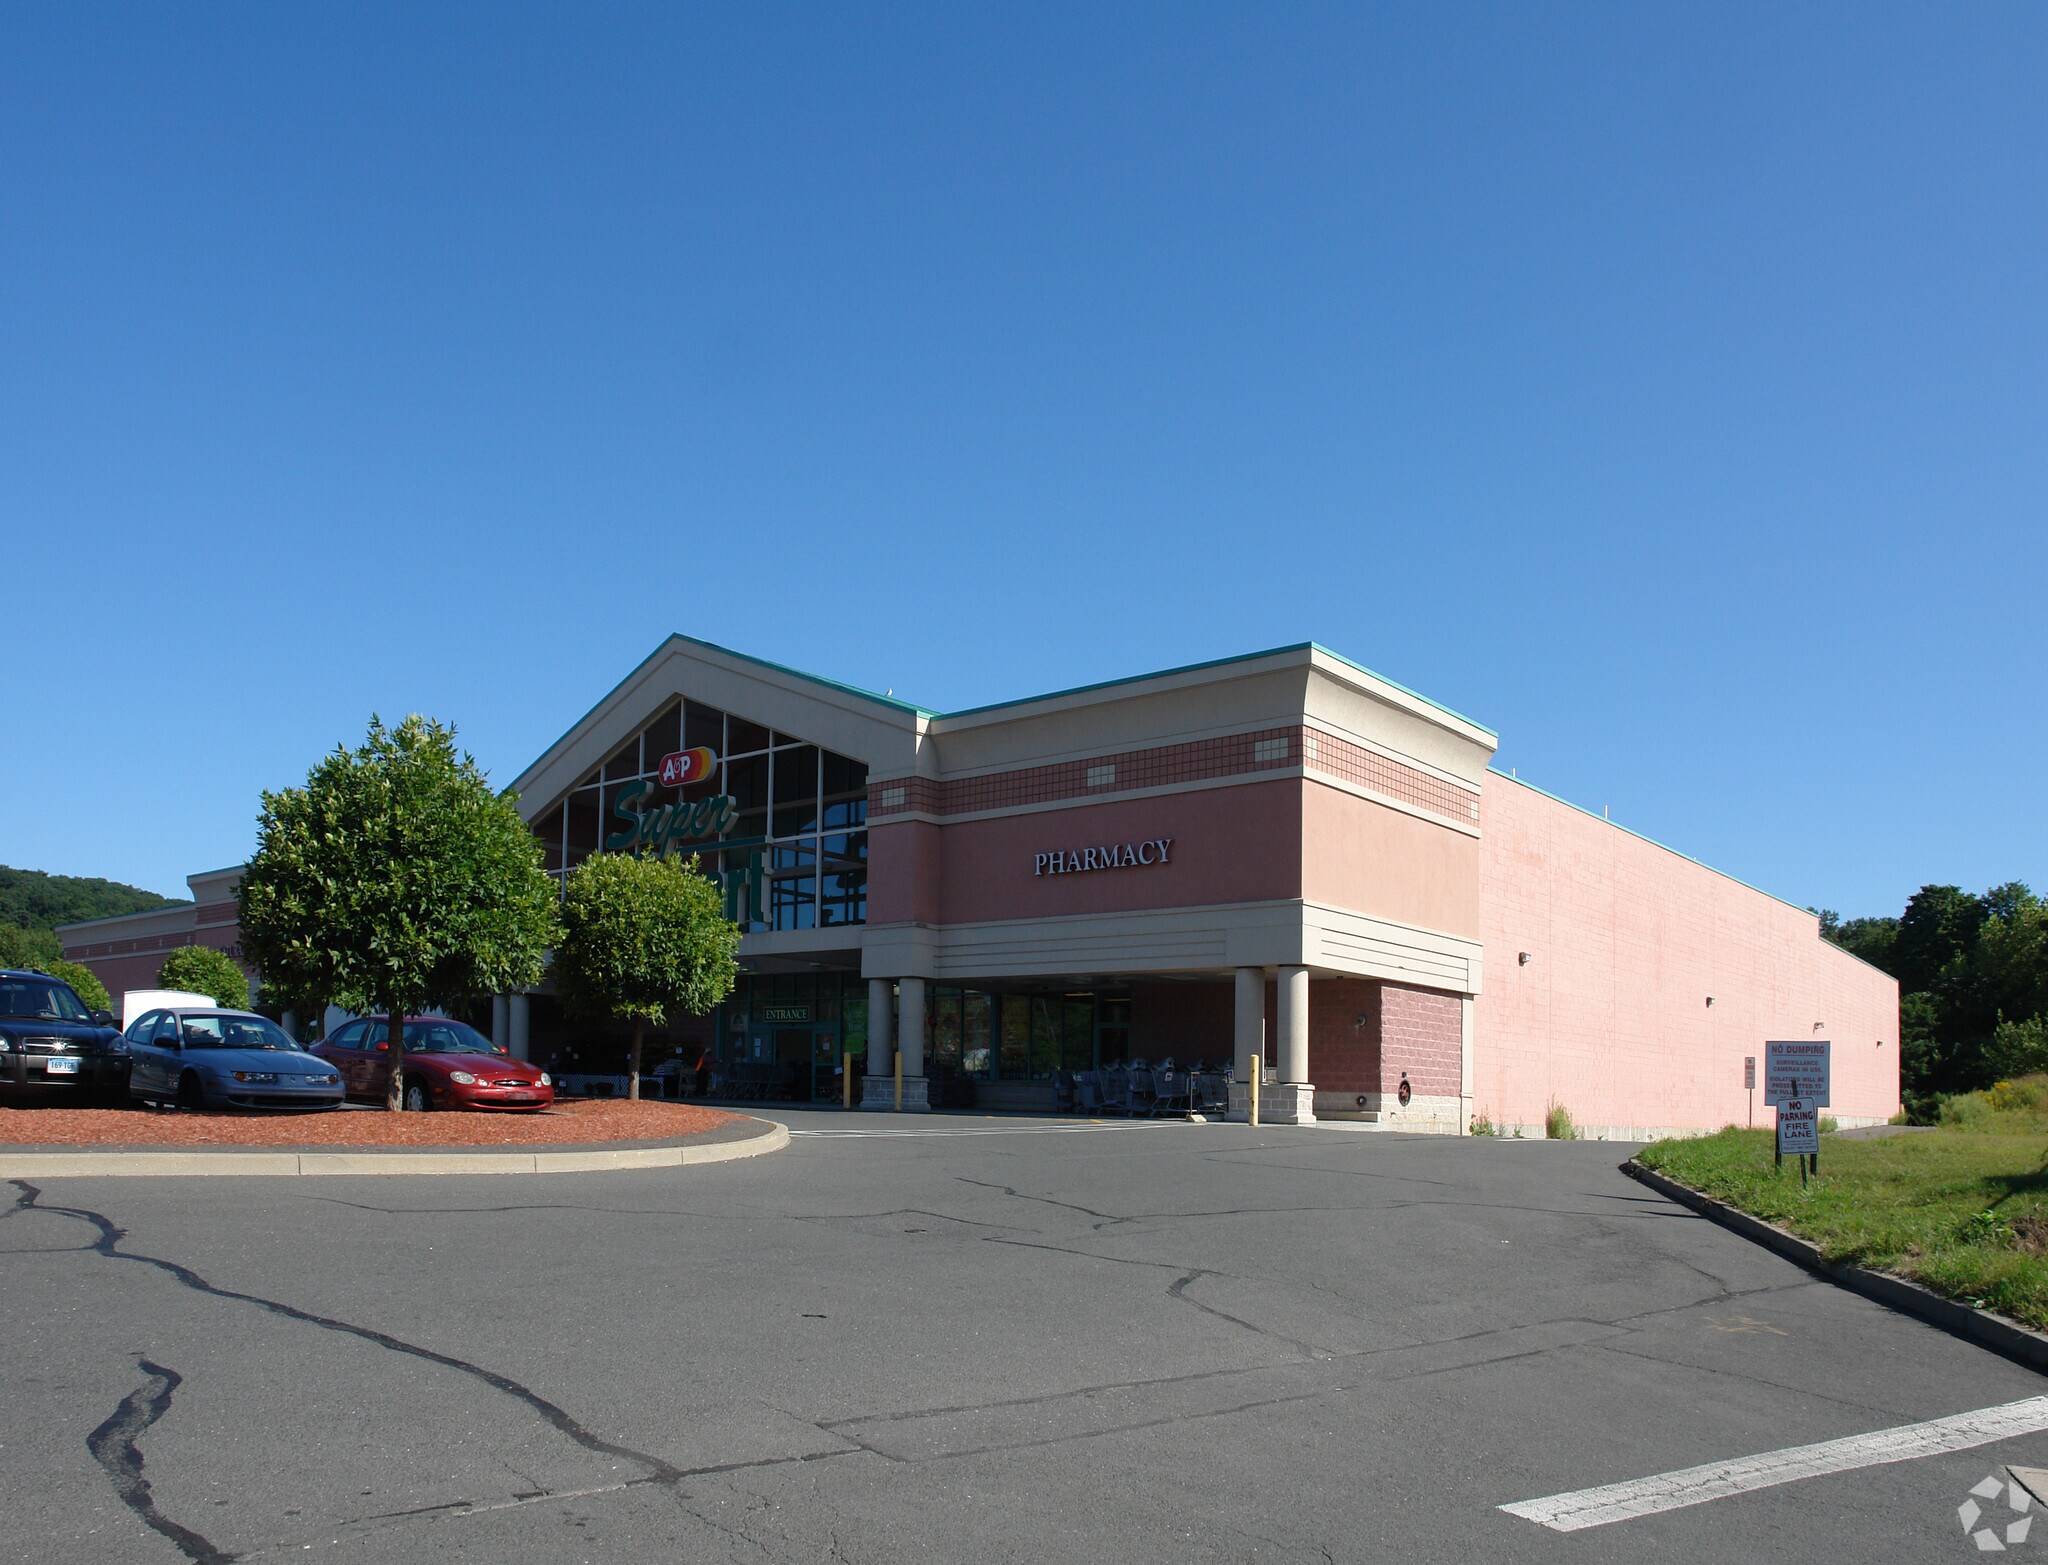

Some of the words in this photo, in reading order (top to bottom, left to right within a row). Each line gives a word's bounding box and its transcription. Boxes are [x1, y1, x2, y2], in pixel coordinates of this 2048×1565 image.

[663, 756, 690, 781] A&P
[606, 781, 738, 859] Super
[1034, 839, 1171, 875] PHARMACY
[766, 1009, 807, 1019] ENTRANCE
[1772, 1045, 1782, 1053] NO
[1787, 1046, 1824, 1054] DUMPING
[1789, 1101, 1801, 1110] NO
[1780, 1111, 1813, 1121] PARKING
[1786, 1122, 1809, 1130] FIRE
[1784, 1130, 1813, 1138] LANE
